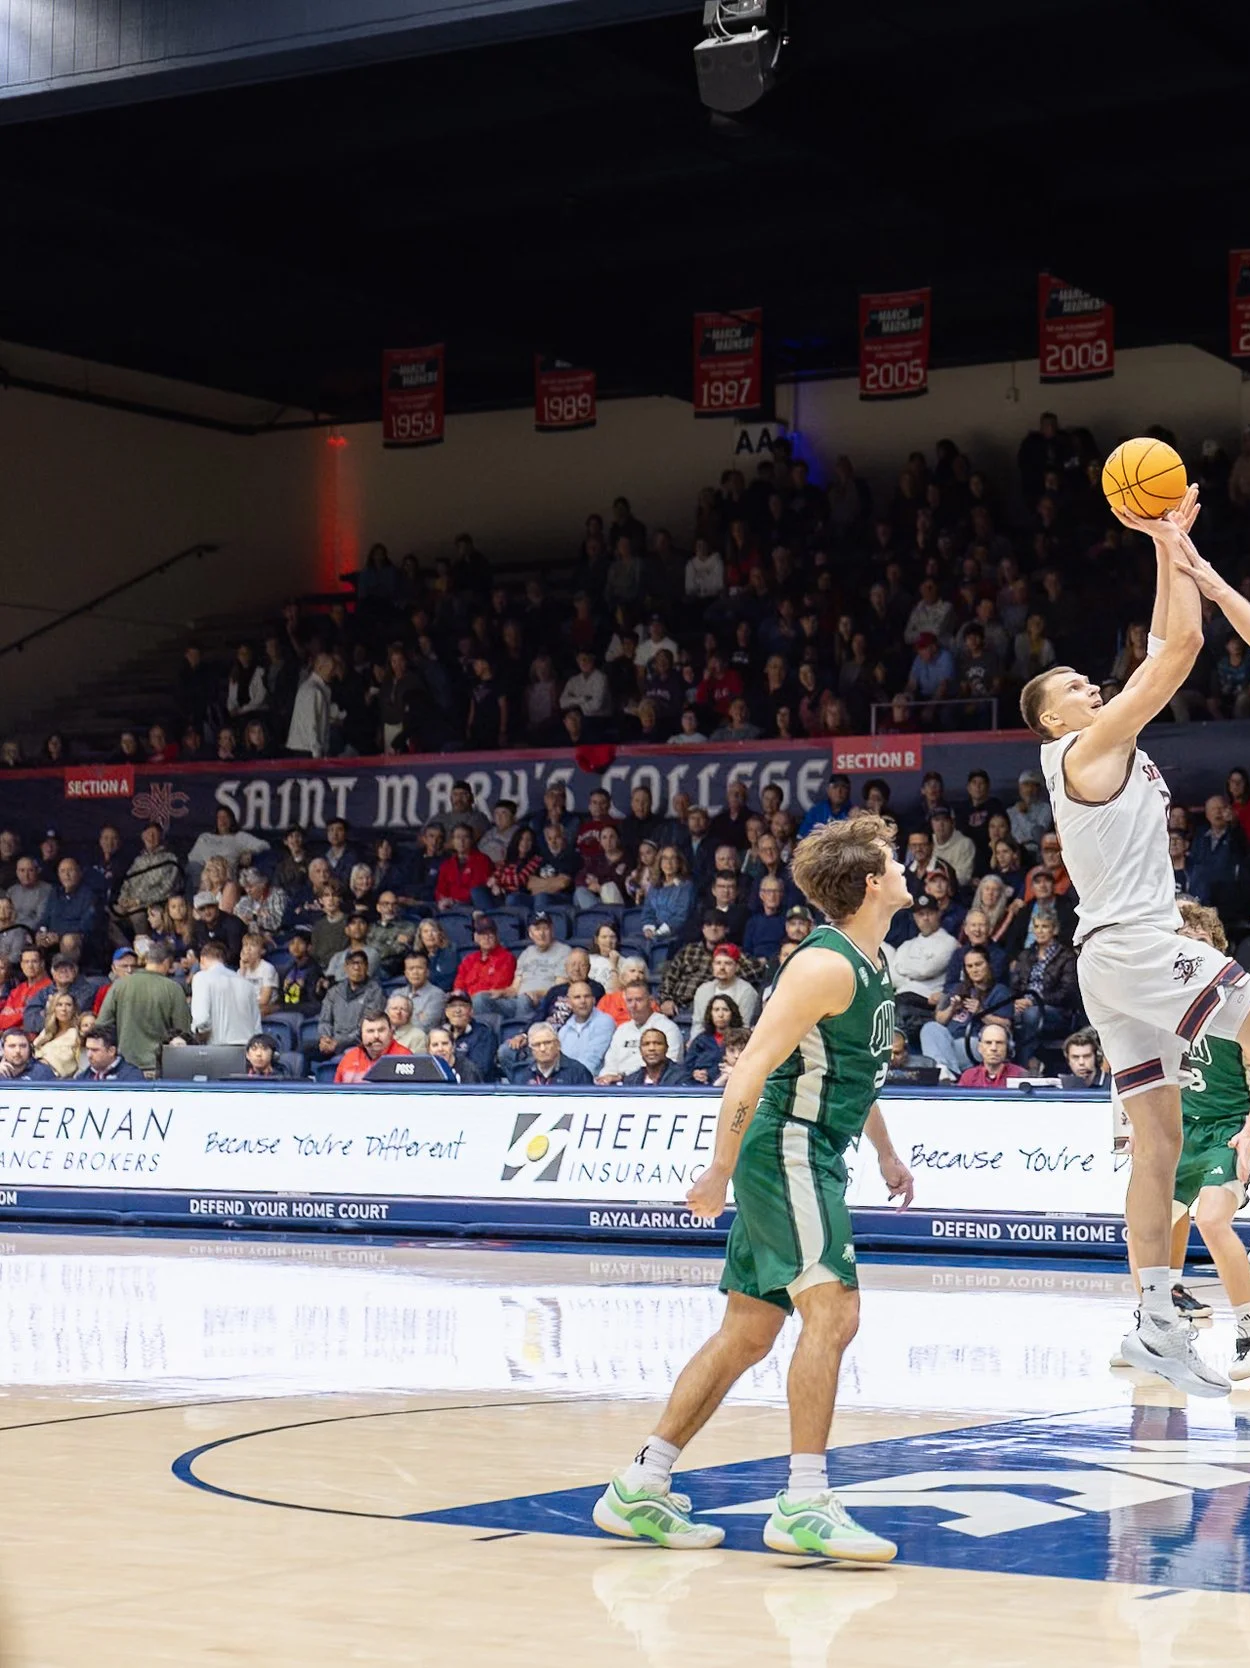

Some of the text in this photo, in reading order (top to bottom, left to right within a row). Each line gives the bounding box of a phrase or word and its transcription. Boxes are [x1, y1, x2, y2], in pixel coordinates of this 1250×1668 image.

[1045, 339, 1108, 371] 2008
[865, 358, 924, 389] 2005
[702, 377, 752, 406] 1997
[543, 393, 592, 421] 1989
[391, 411, 436, 438] 1959
[735, 426, 773, 455] AA
[836, 751, 916, 770] SECTION B
[67, 779, 130, 796] SECTION A
[214, 776, 358, 830] SAINT
[599, 758, 830, 820] COLLEGE
[204, 1131, 281, 1155] Because
[365, 1128, 467, 1161] Different
[910, 1144, 1003, 1170] Because
[63, 1151, 160, 1172] BROKERS
[189, 1199, 389, 1220] DEFEND YOUR HOME COURT
[589, 1211, 716, 1229] BAYALARM.COM
[931, 1220, 1003, 1239] DEFEND
[1007, 1223, 1058, 1240] YOUR
[1062, 1225, 1115, 1243] HOME
